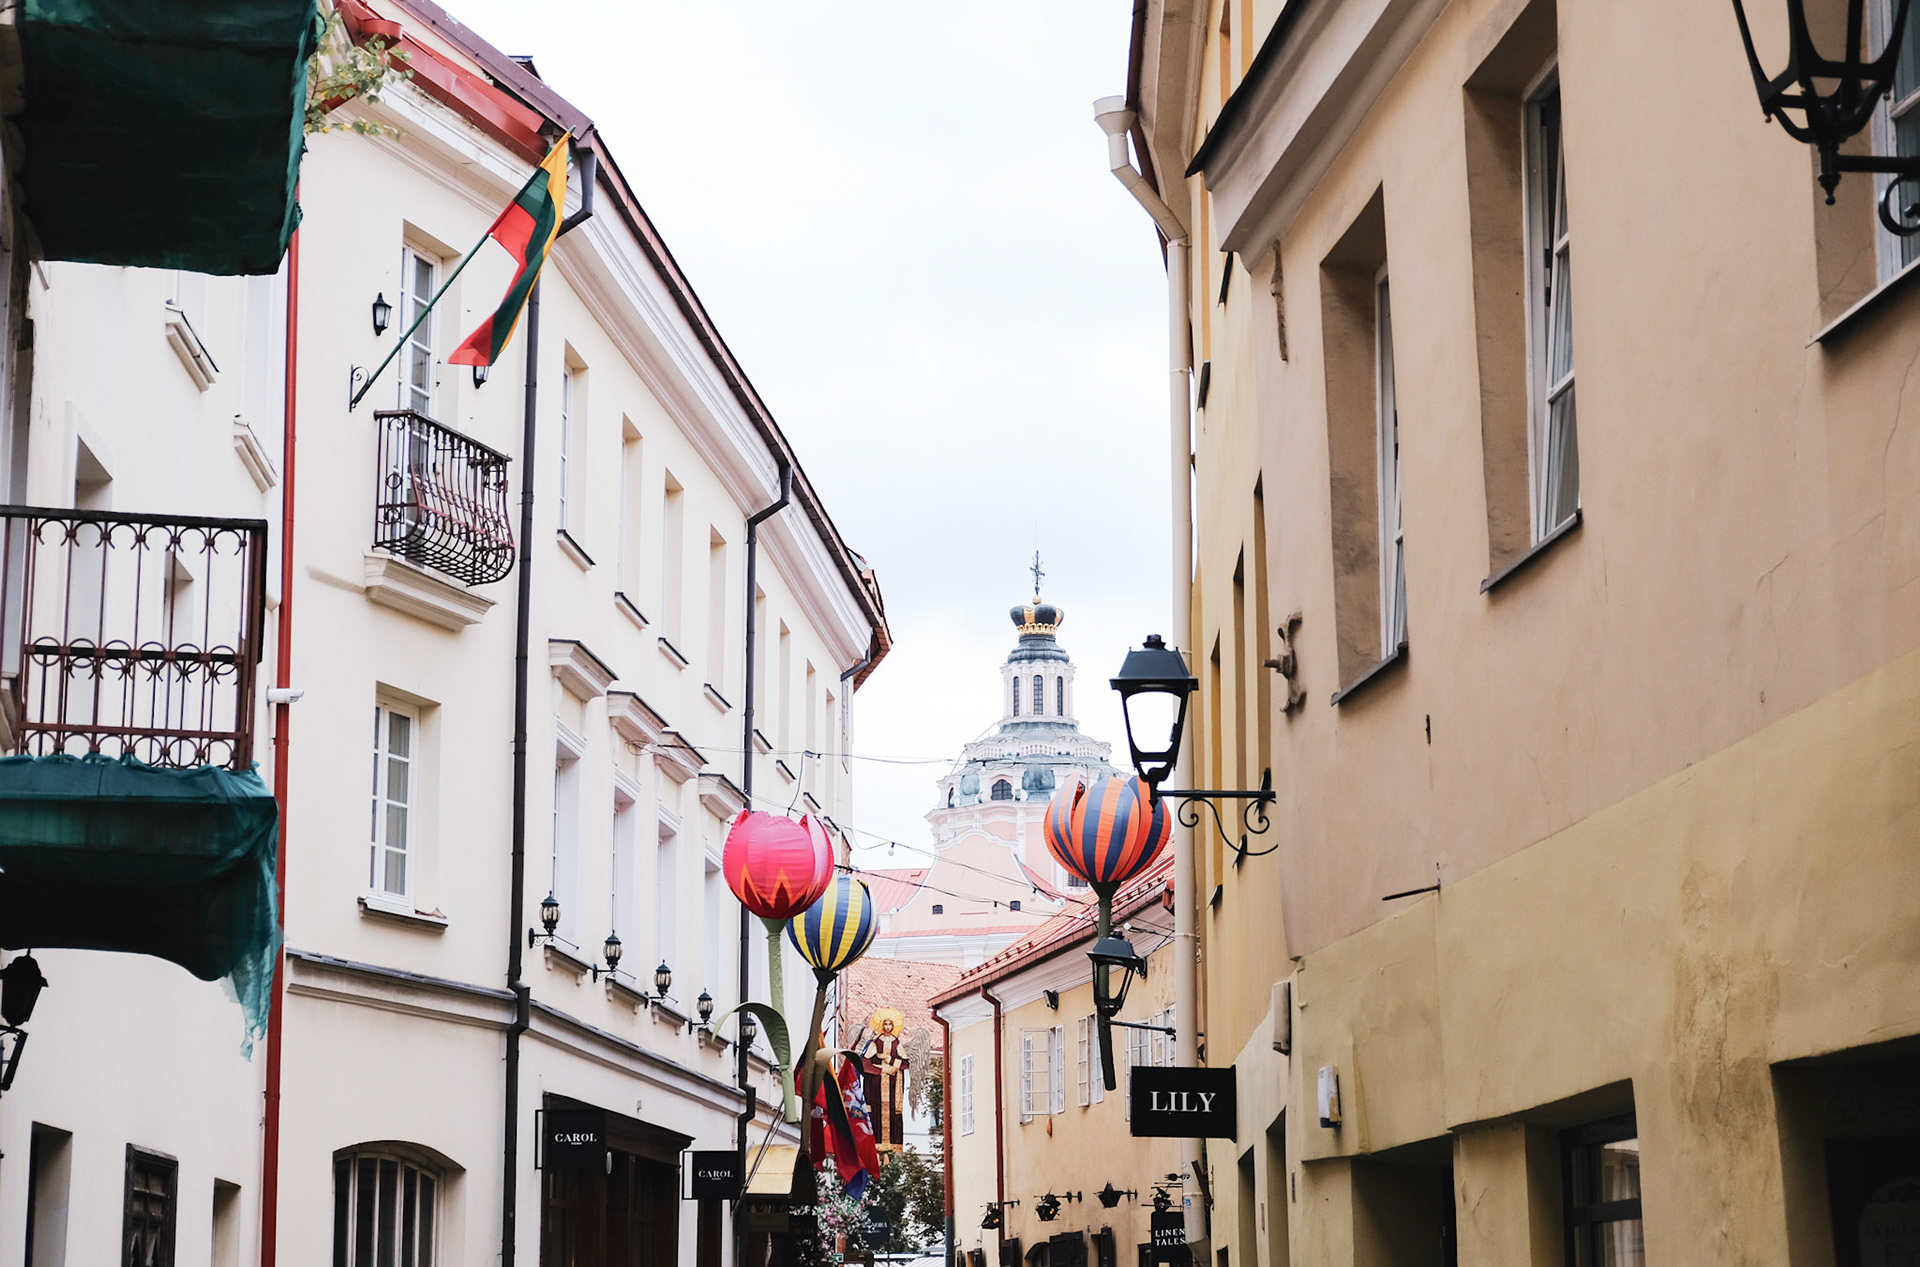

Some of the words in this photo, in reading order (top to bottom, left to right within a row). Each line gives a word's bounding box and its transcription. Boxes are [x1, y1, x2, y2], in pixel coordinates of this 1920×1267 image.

[1150, 1091, 1216, 1112] LILY
[554, 1133, 598, 1143] CAROL
[698, 1170, 734, 1178] CAROL
[1155, 1228, 1185, 1237] LINEN
[1155, 1237, 1185, 1246] TALES
